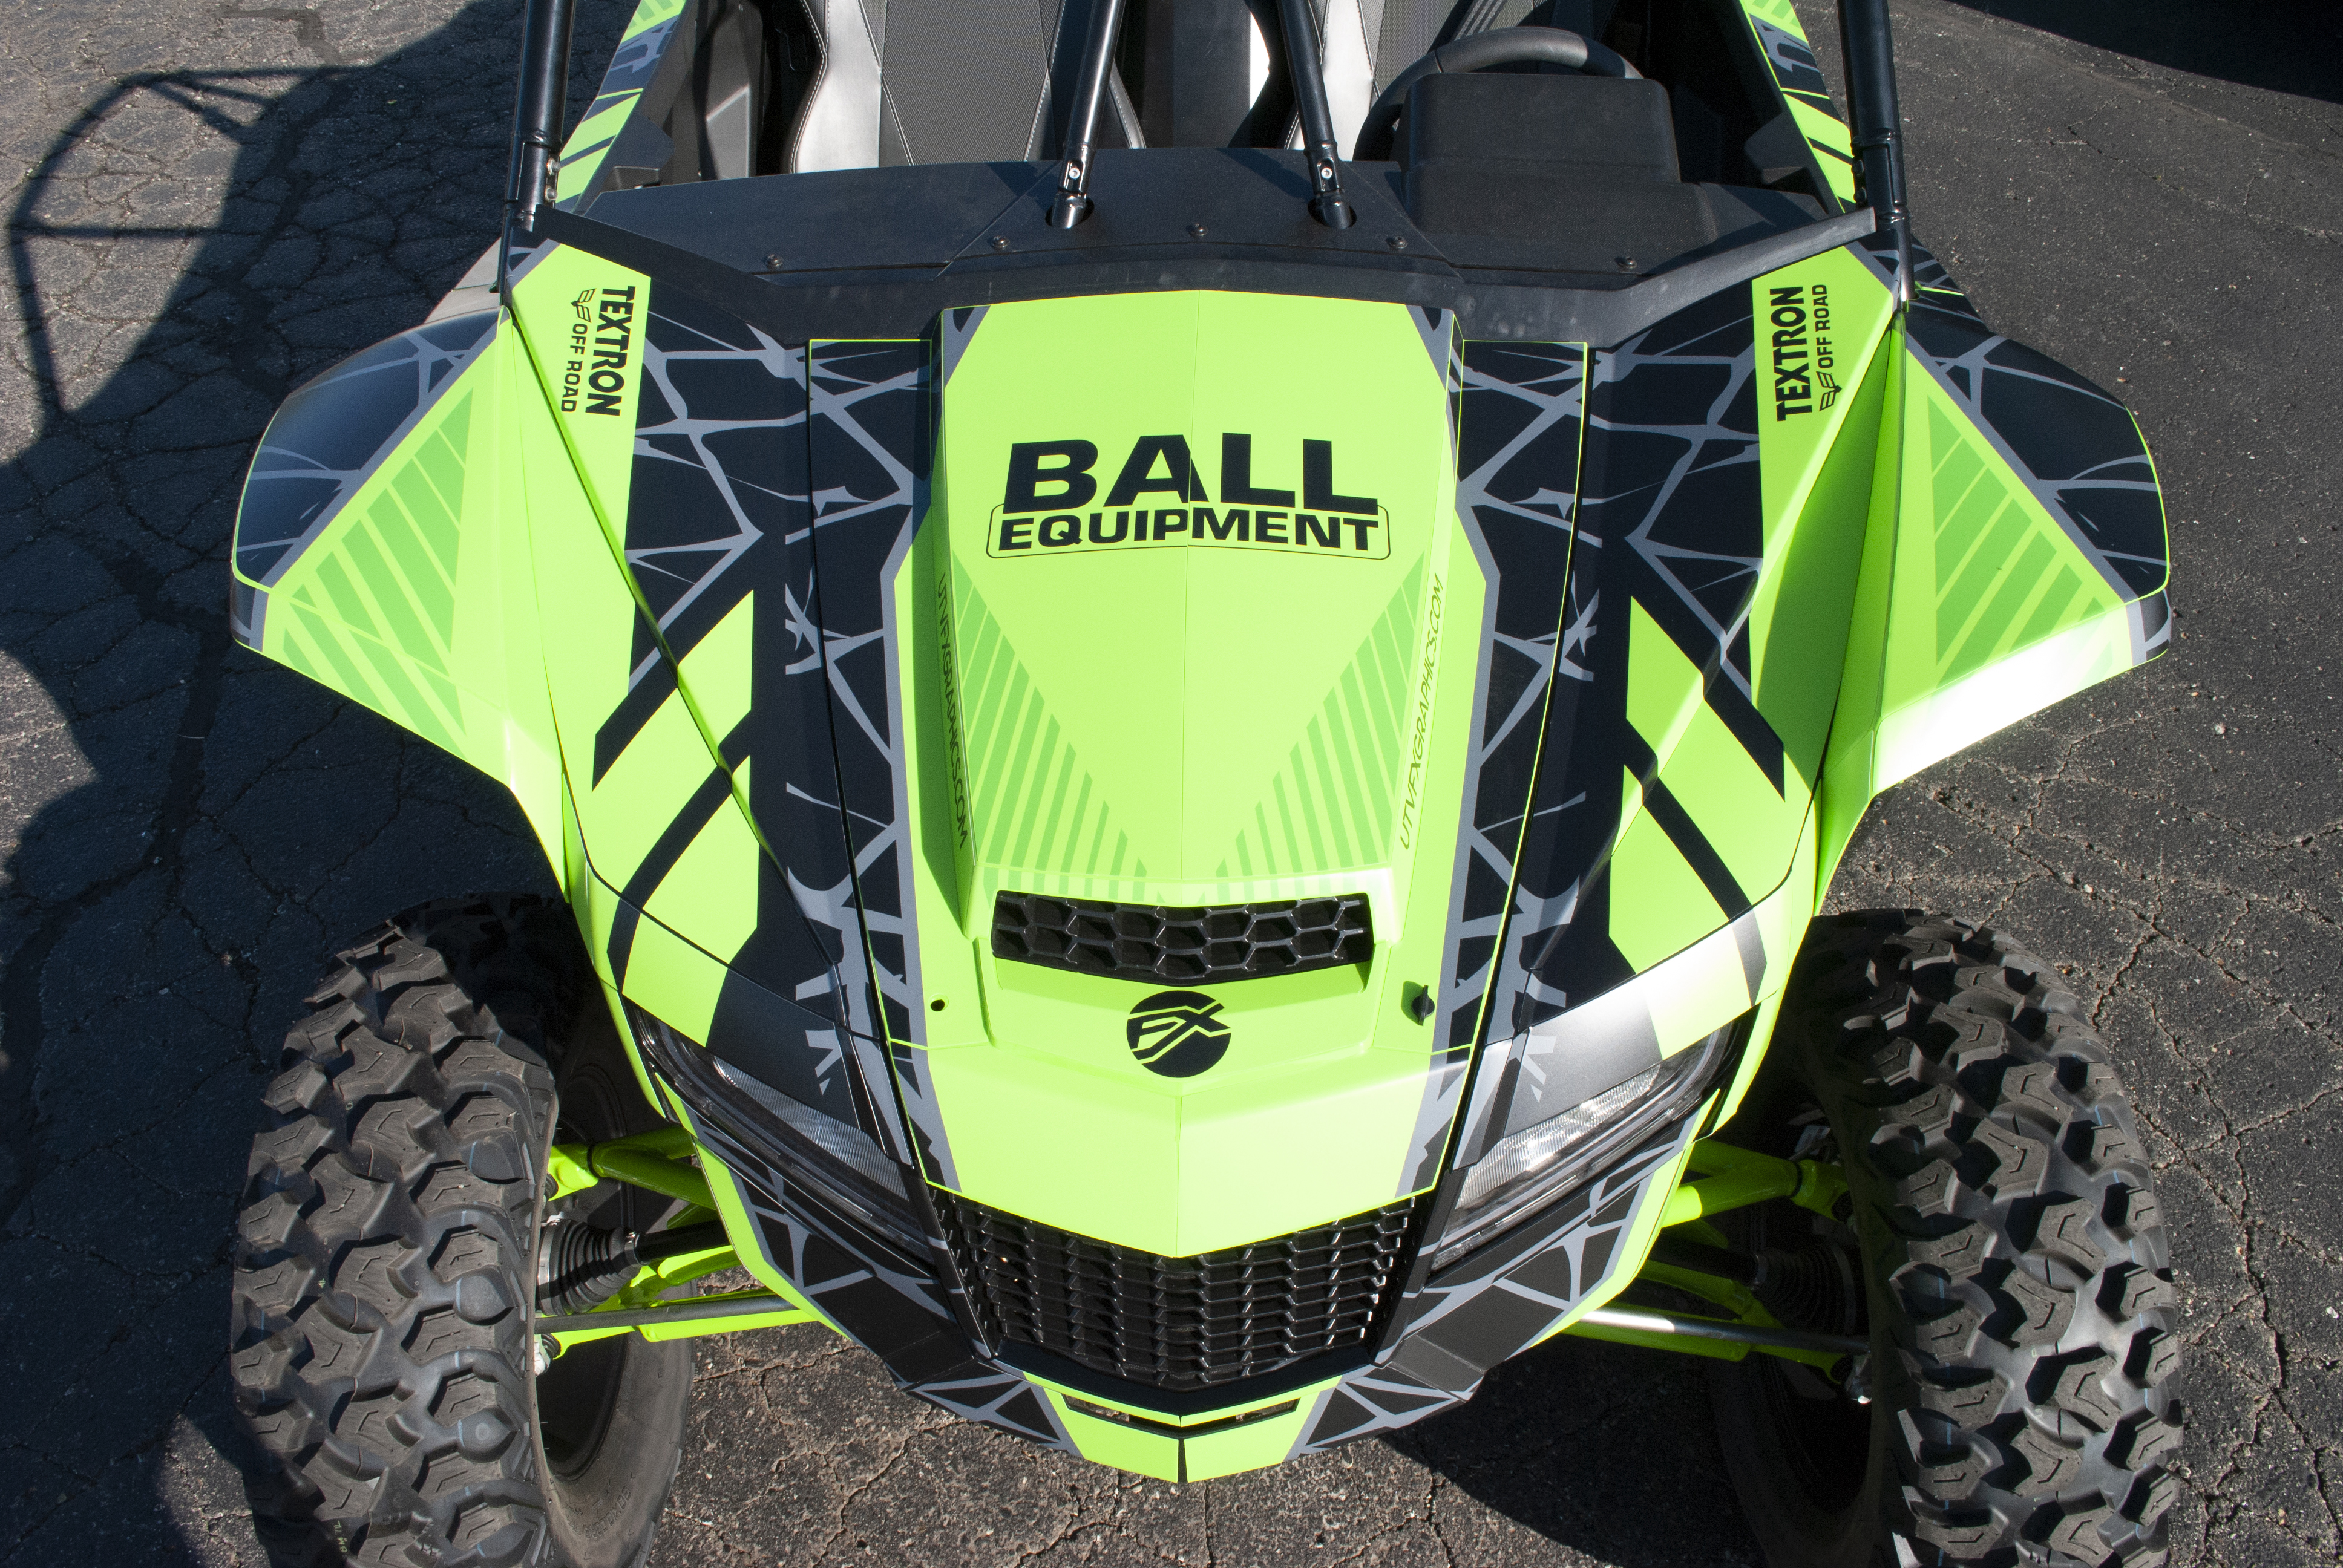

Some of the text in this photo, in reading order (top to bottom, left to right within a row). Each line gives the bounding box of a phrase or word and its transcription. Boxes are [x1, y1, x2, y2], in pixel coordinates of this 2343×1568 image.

[561, 324, 588, 413] OFF ROAD
[585, 286, 636, 416] TEXTRON
[1769, 286, 1812, 422] TEXTRON
[1812, 284, 1834, 369] OFF ROAD
[1003, 433, 1378, 516] BALL
[998, 507, 1378, 552] EQUIPMENT
[937, 572, 968, 850] UTVFXGRAPHICS.COM
[1399, 572, 1444, 851] UTVFXGRAPHICS.COM
